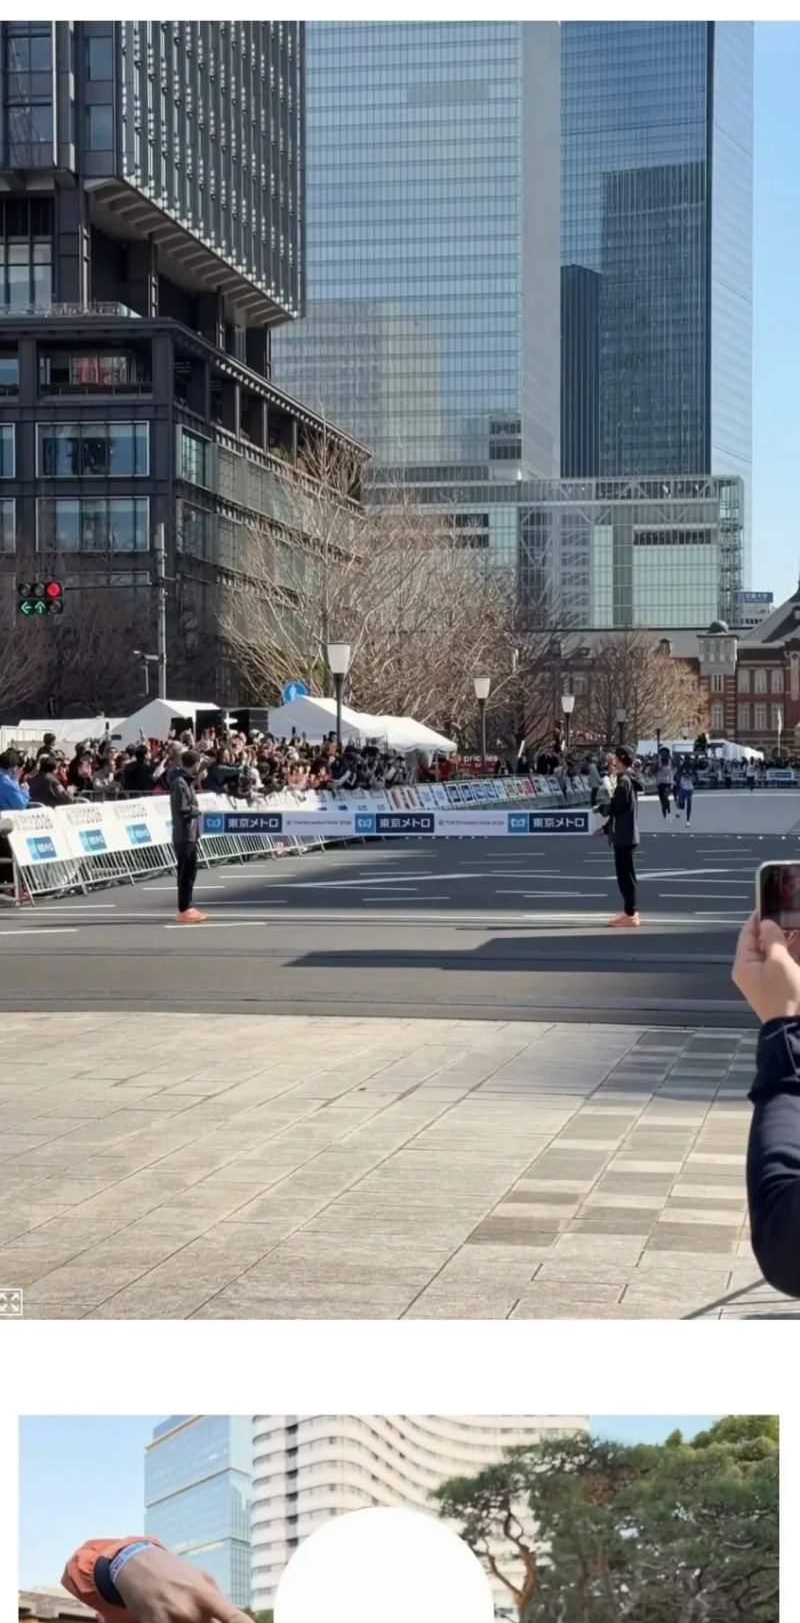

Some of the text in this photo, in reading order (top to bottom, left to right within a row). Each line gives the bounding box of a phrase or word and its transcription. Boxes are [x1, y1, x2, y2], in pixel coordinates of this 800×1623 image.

[227, 818, 280, 828] 東京メトロ
[379, 818, 431, 828] 東京メトロ
[532, 818, 585, 828] 東京メトロ
